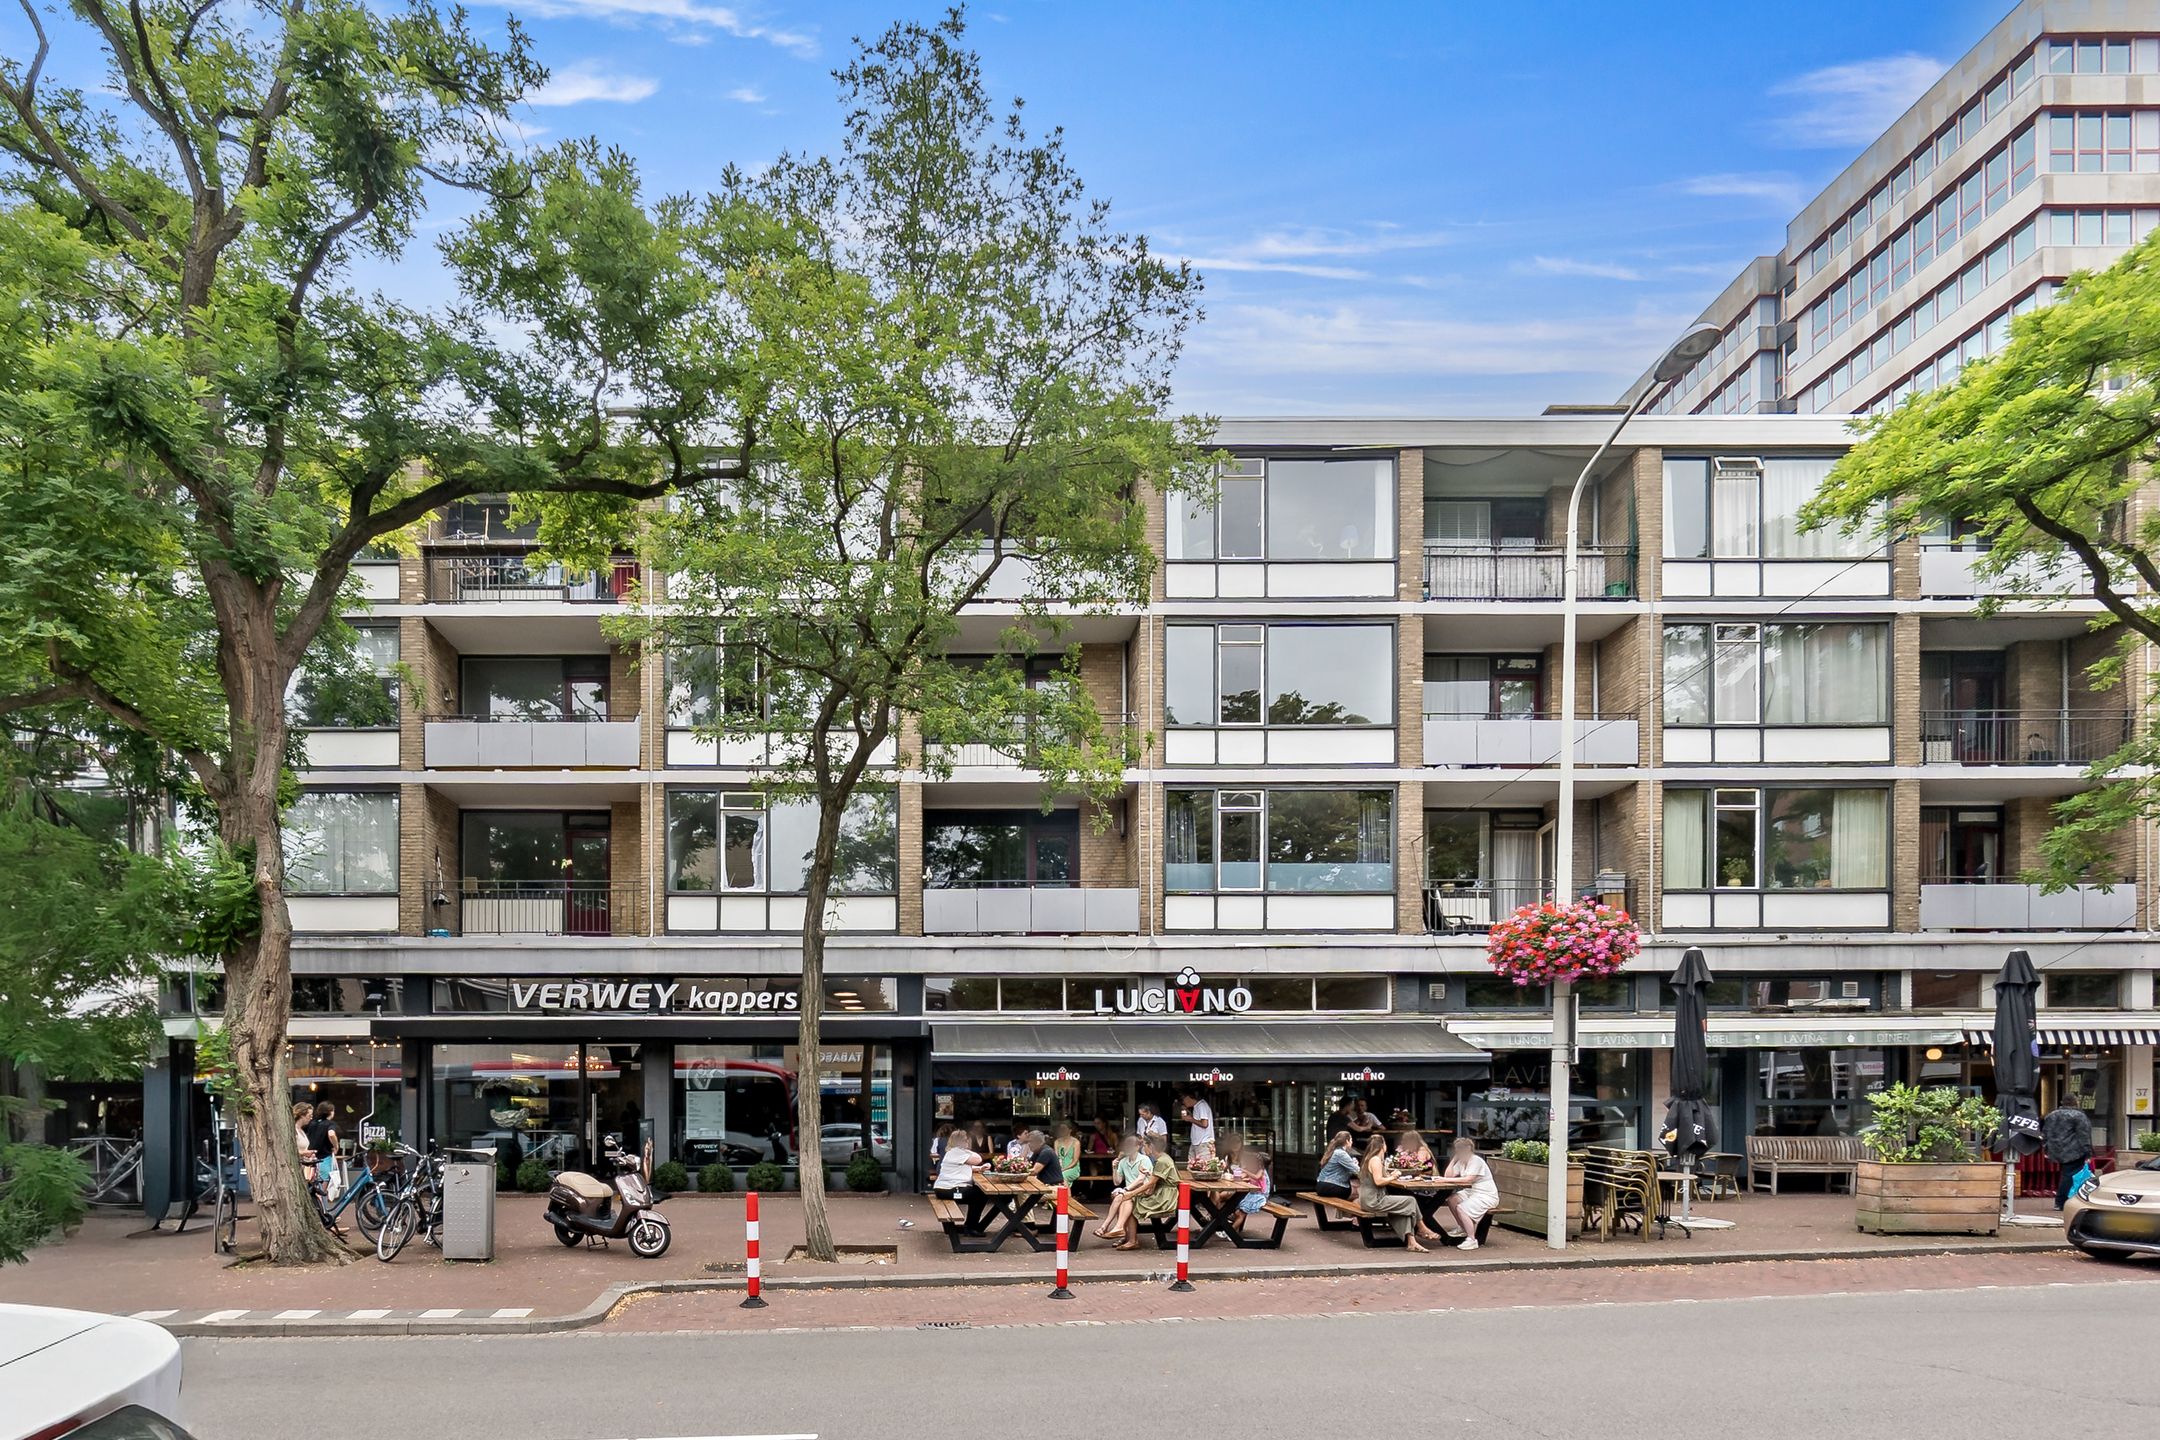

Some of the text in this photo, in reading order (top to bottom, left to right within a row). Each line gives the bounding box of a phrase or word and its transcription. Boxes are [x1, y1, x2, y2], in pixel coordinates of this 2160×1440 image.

[512, 983, 797, 1014] VERWEY kappers
[1095, 988, 1252, 1013] LUCIANO
[1508, 1036, 1547, 1046] LUNCH
[1706, 1034, 1732, 1045] RREL
[1876, 1033, 1911, 1043] DINER
[1492, 1065, 1585, 1085] LAVIA
[2008, 1114, 2040, 1131] FFE
